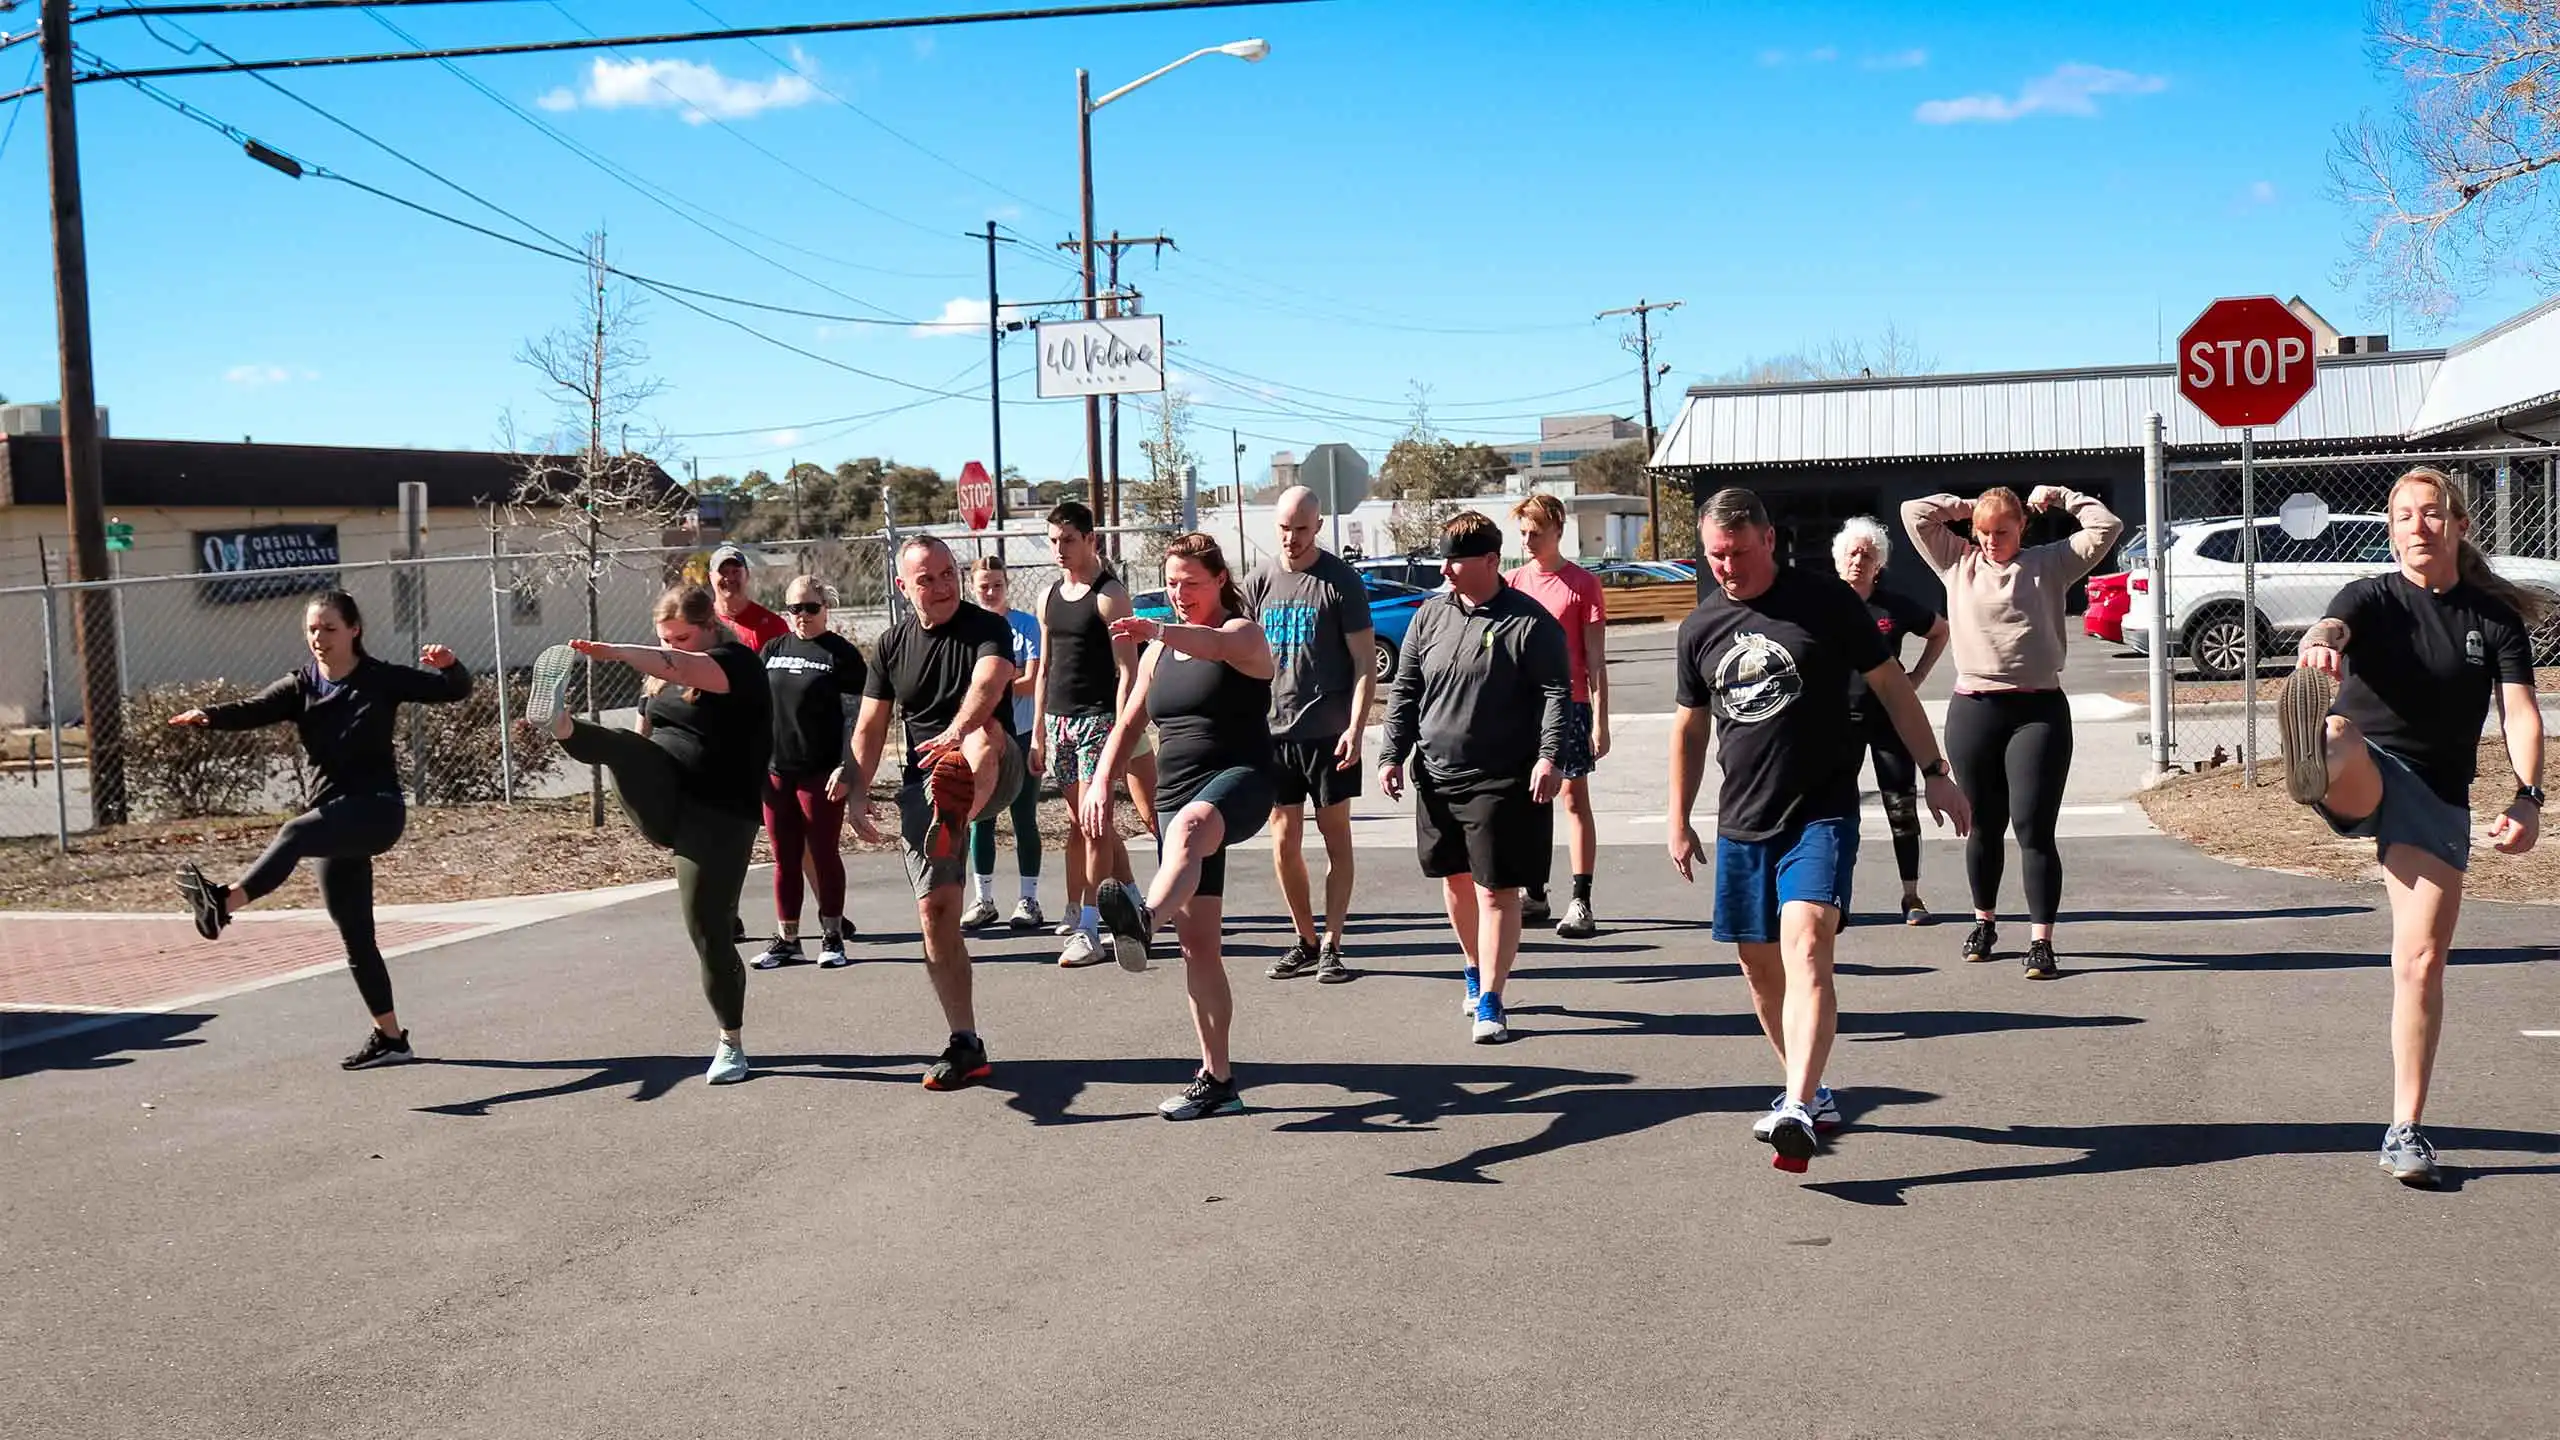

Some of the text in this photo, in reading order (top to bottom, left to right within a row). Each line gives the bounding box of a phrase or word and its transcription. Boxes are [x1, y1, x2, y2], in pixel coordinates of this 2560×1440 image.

[1046, 337, 1076, 375] 40
[2188, 337, 2305, 388] STOP
[961, 482, 991, 510] STOP
[252, 536, 302, 550] ORSINI
